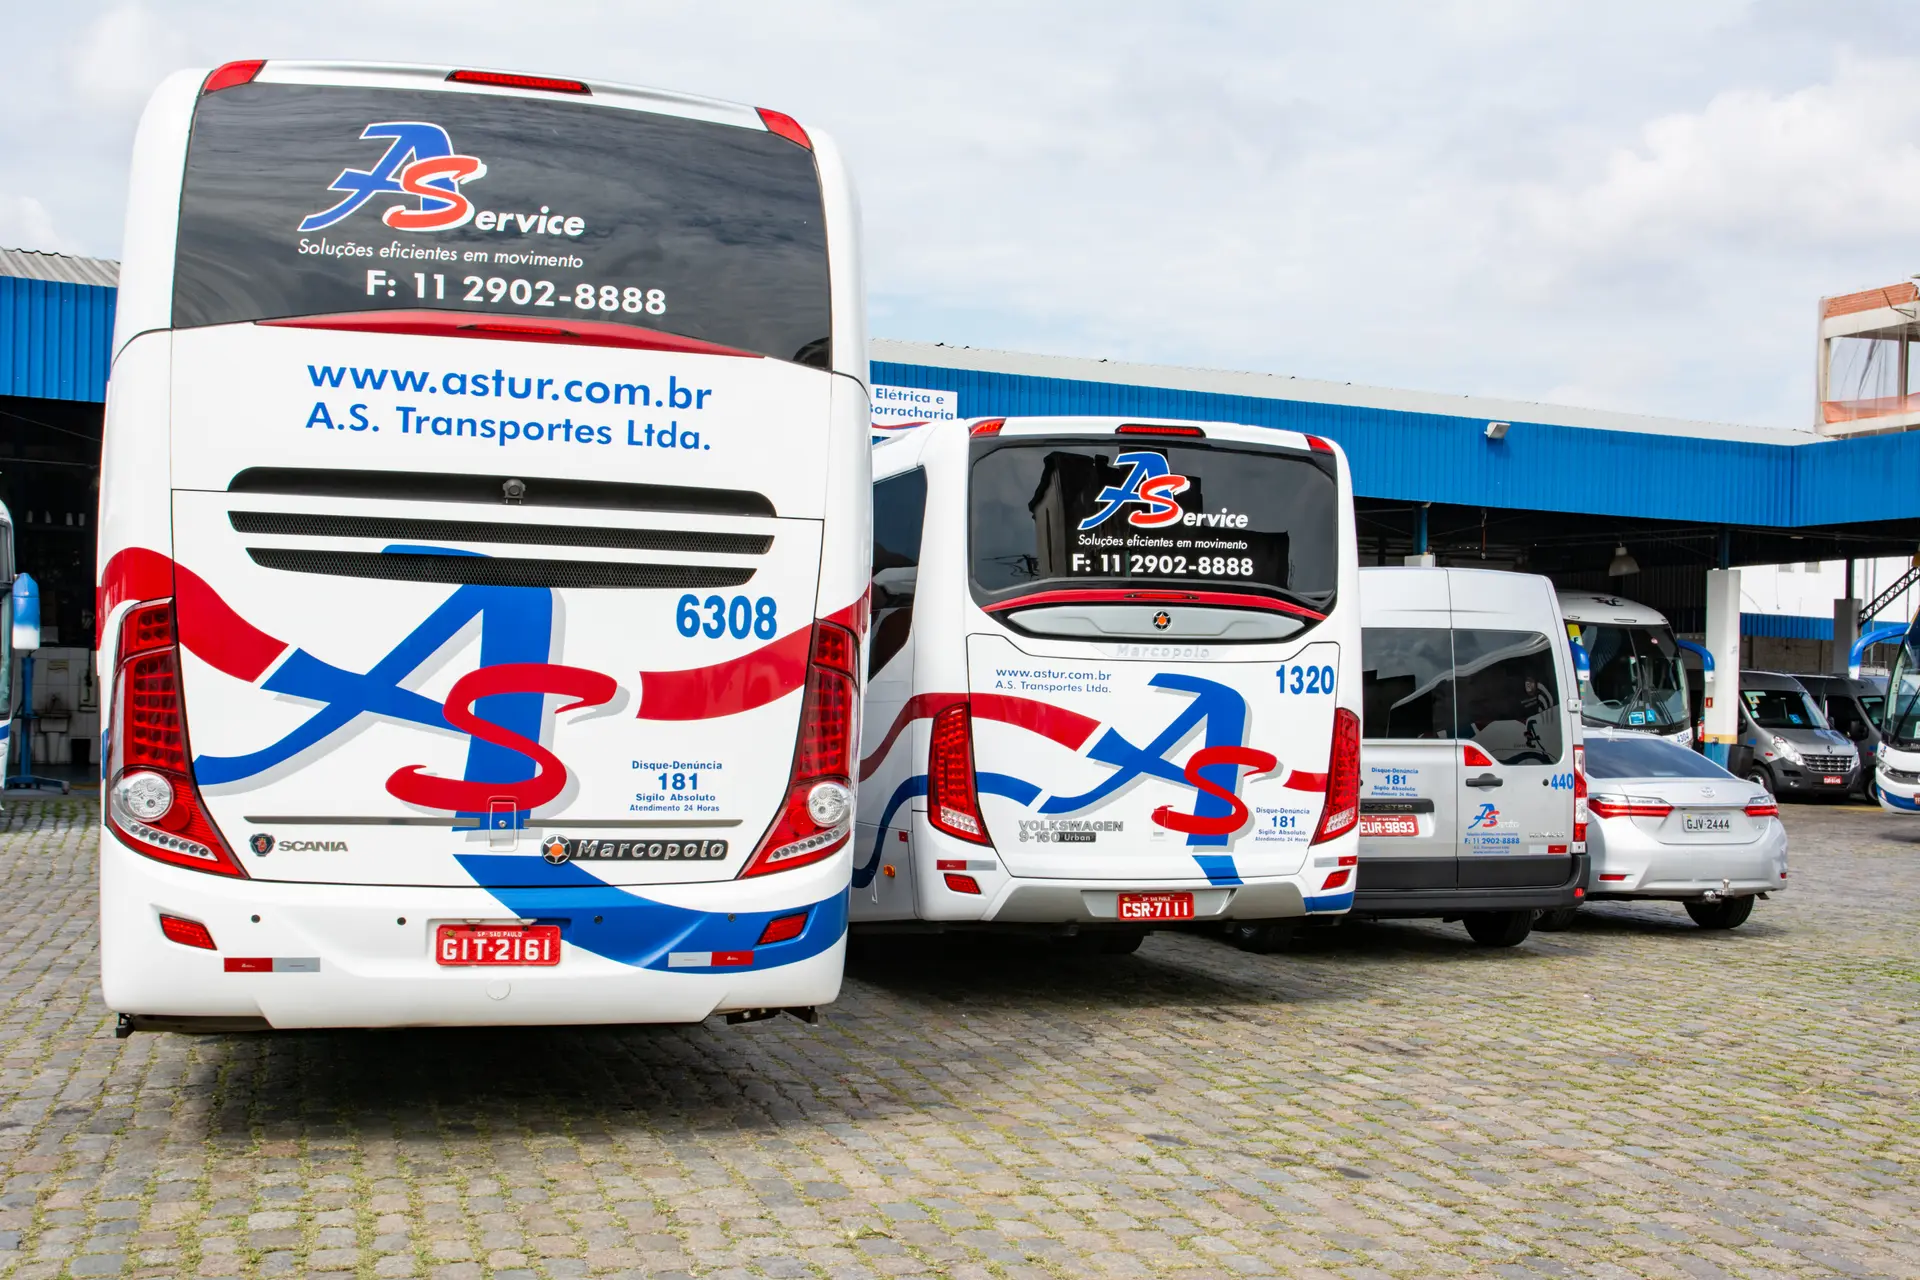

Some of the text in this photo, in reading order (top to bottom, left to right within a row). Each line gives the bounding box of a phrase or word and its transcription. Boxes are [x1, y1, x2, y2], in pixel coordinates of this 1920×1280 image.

[298, 238, 584, 269] Soluções eficientes em movimento
[366, 270, 667, 315] F: 11 2902-8888
[307, 364, 712, 410] www.astur.com.br
[875, 388, 945, 405] Elétrica e
[306, 402, 711, 451] A.S. Transportes Ltda.
[1078, 533, 1248, 550] Soluções eficientes em movimento
[1072, 553, 1254, 577] F: 11 2902-8888
[676, 593, 778, 641] 6308
[1116, 643, 1210, 659] Marcopolo
[995, 668, 1112, 681] www.astur.com.br
[1275, 664, 1335, 695] 1320
[995, 680, 1112, 693] A.S. Transportes Ltda.
[632, 760, 722, 771] Disque-Denúncia
[658, 773, 698, 790] 181
[1385, 774, 1407, 785] 181
[1550, 773, 1574, 790] 440
[636, 793, 715, 802] Sigilo Absoluto
[1018, 820, 1124, 832] VOLKSWAGEN
[1272, 816, 1295, 827] 181
[1019, 830, 1091, 843] 9-160 Urban
[1464, 837, 1471, 845] F:
[1481, 837, 1520, 845] 2902-8888
[279, 840, 349, 852] SCANIA
[576, 840, 724, 860] Marcopolo
